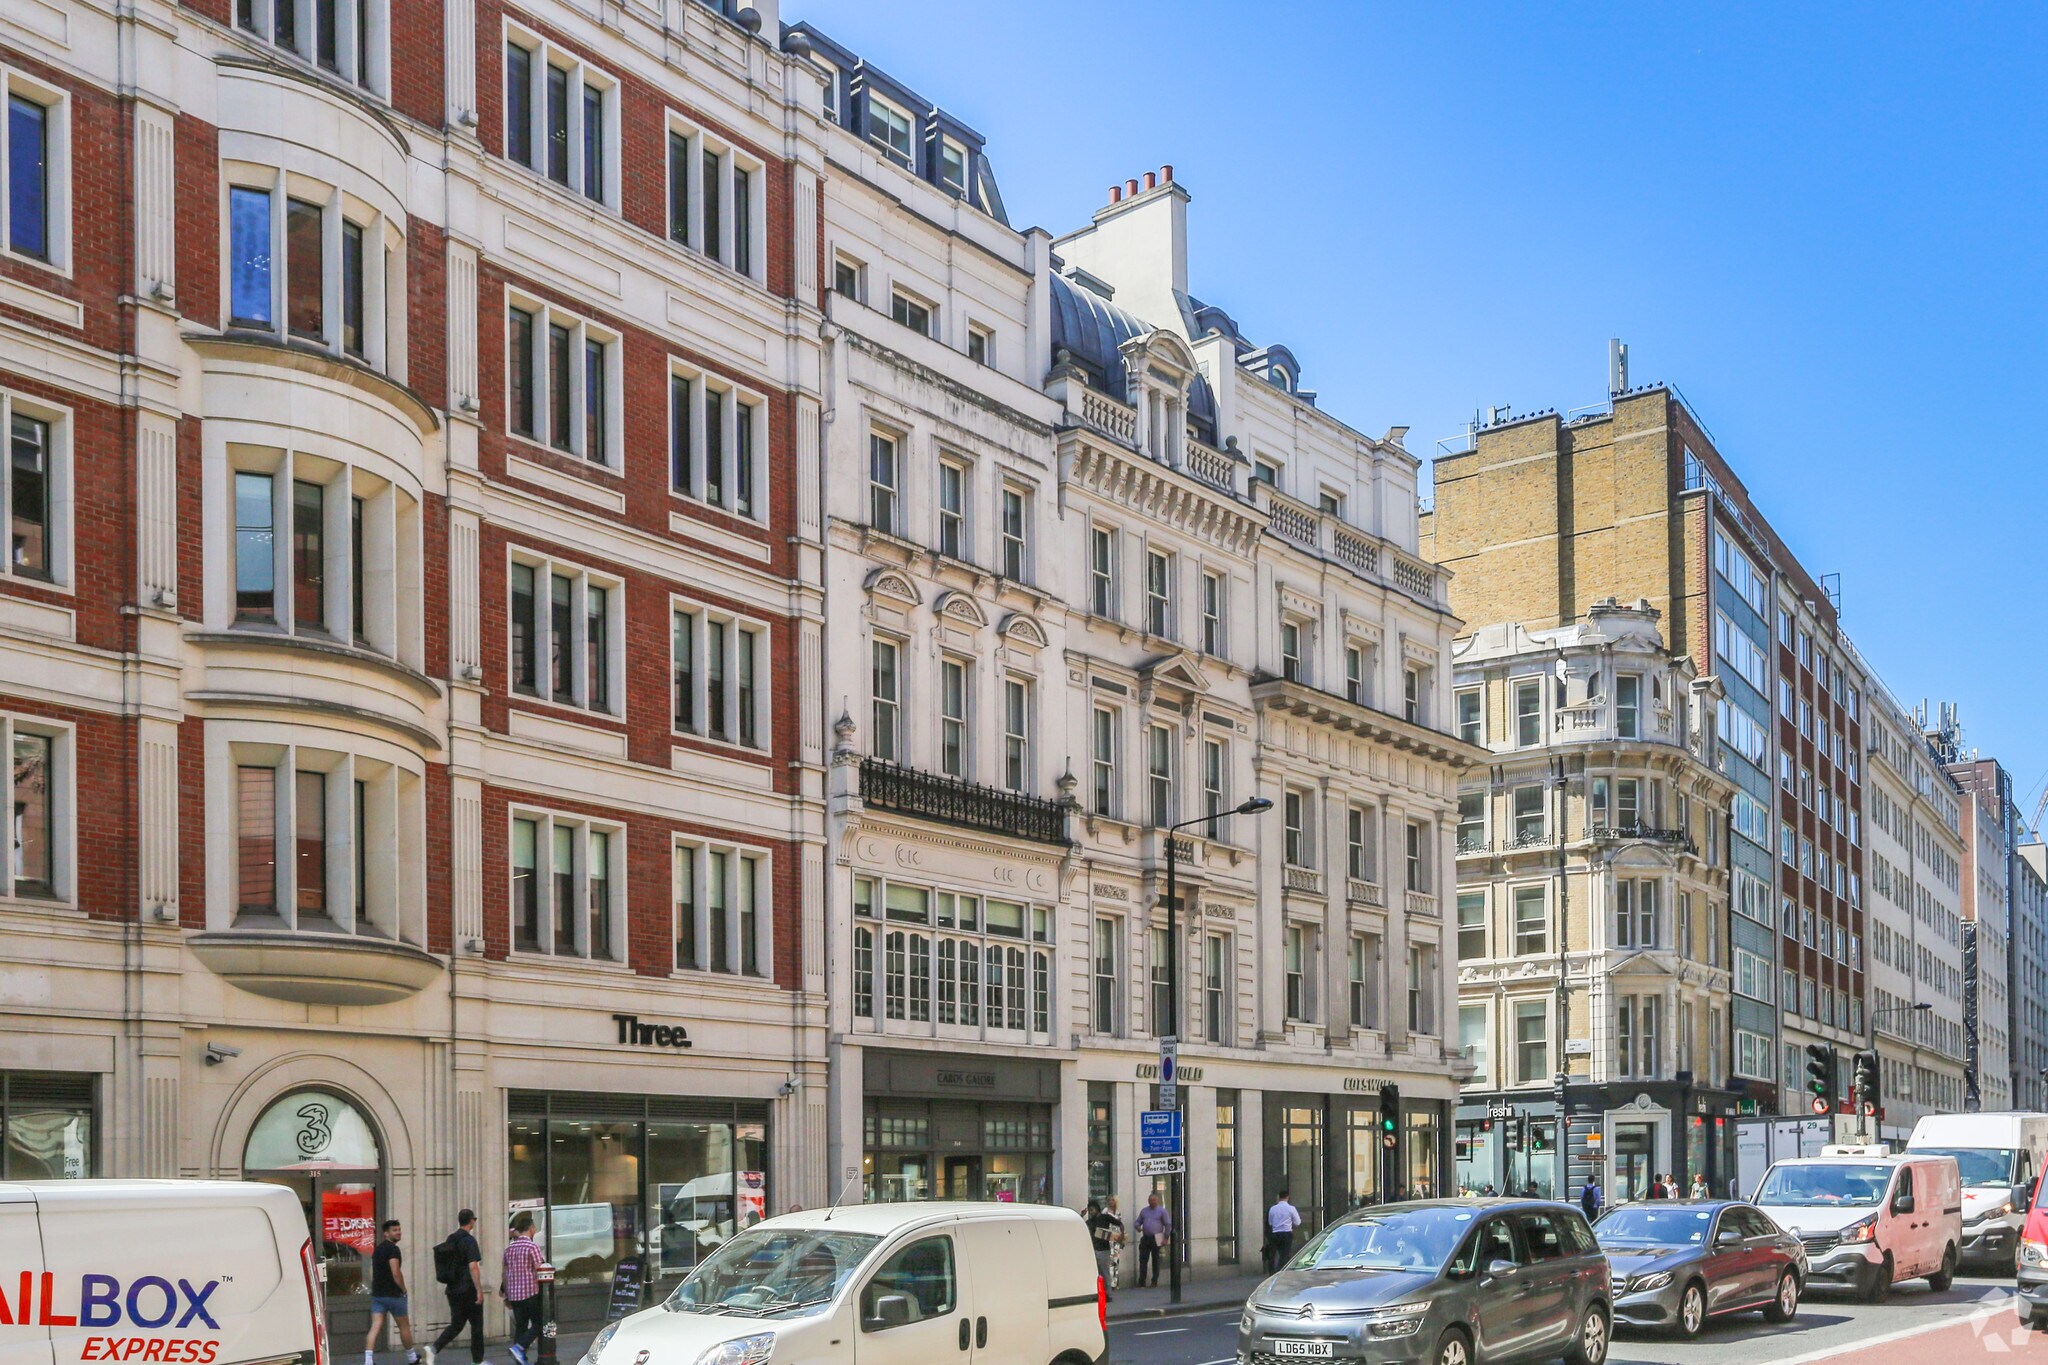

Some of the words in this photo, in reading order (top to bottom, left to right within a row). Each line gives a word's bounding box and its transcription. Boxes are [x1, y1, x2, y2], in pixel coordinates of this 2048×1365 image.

[1136, 1063, 1203, 1081] COTOLD
[1807, 1121, 1817, 1130] 29
[64, 1156, 80, 1167] Free
[309, 1170, 321, 1178] 315
[80, 1337, 220, 1364] EXPRESS
[1279, 1342, 1305, 1354] LD65
